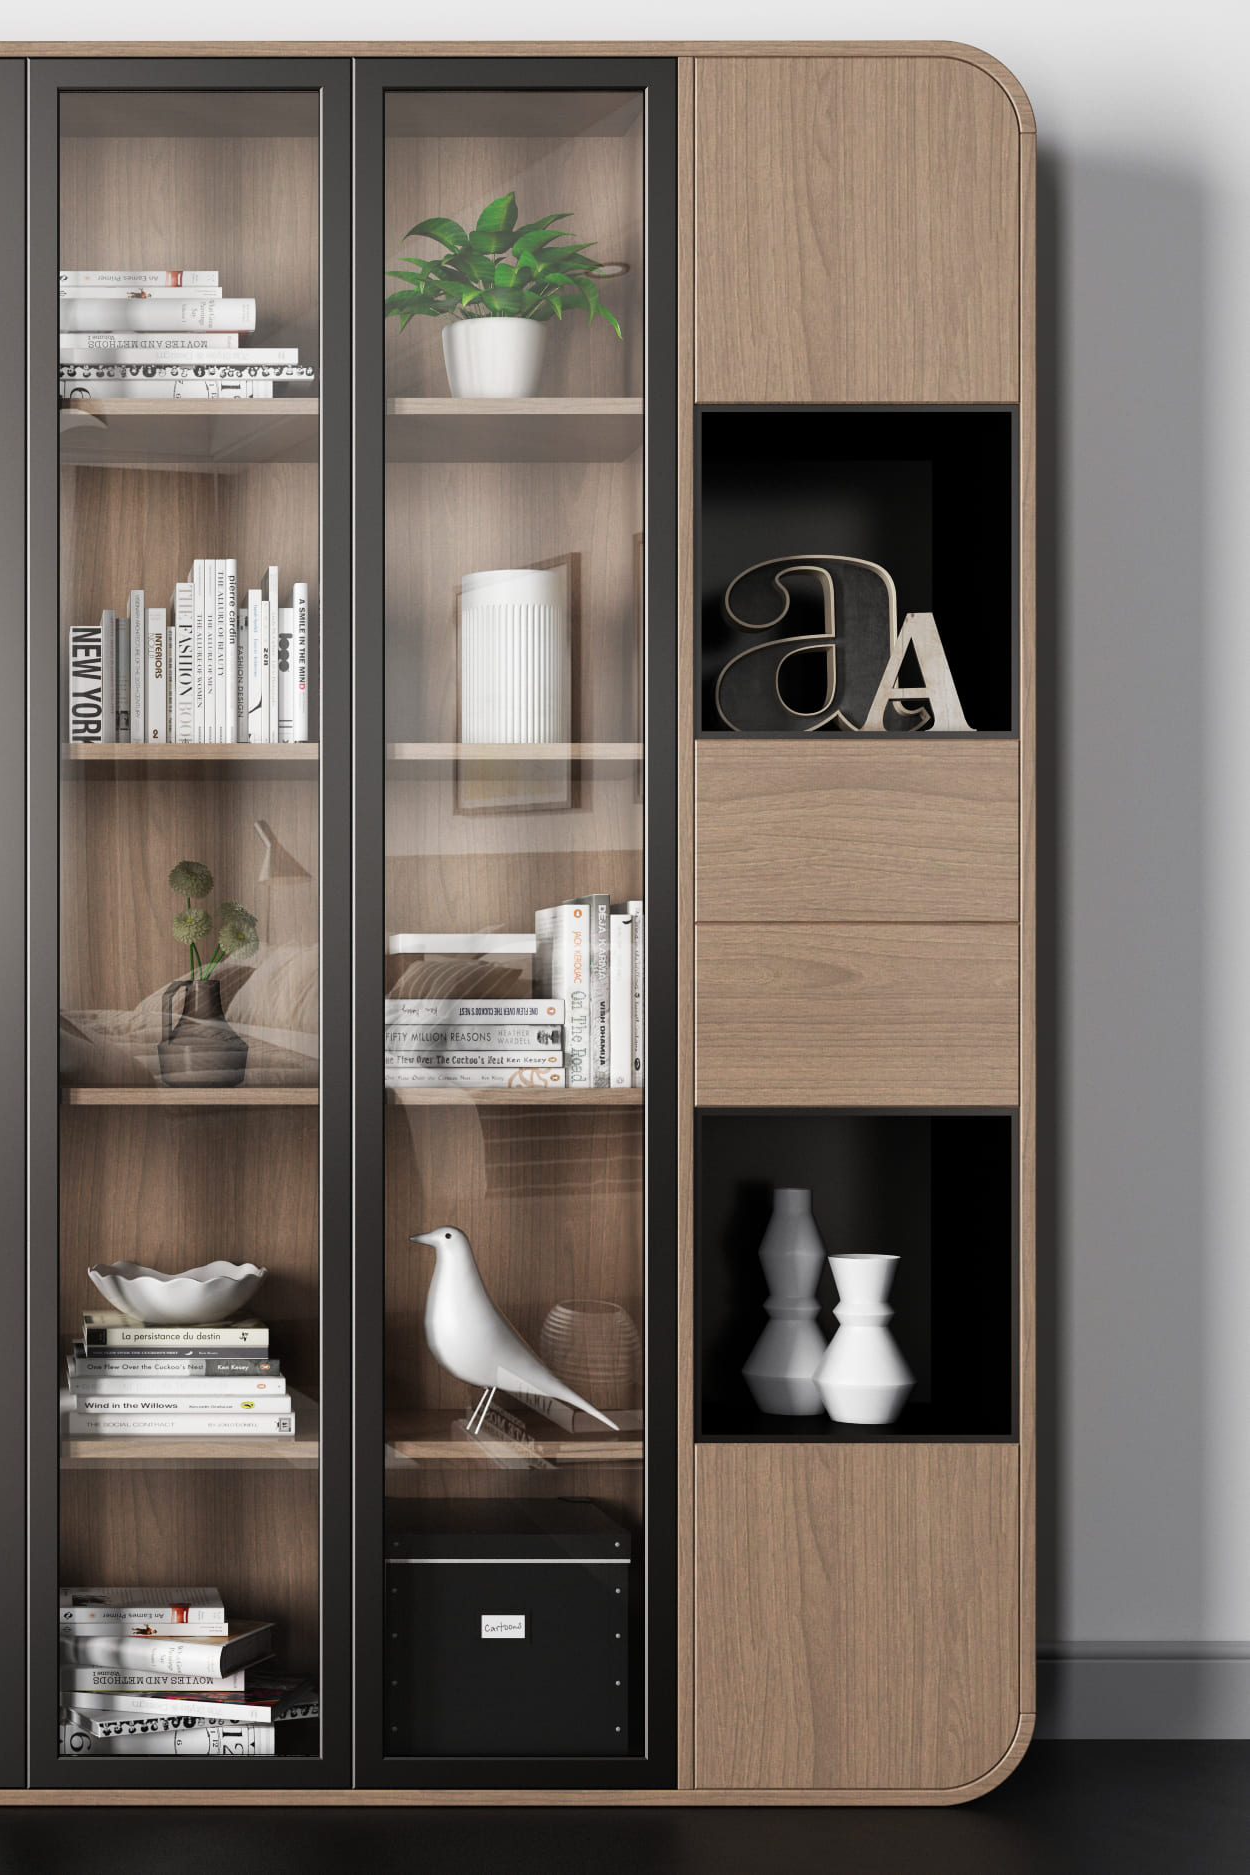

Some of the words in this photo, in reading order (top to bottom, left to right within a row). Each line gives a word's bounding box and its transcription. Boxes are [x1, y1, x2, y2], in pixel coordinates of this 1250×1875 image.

[88, 340, 138, 348] METHODS
[140, 340, 162, 348] AND
[166, 340, 208, 348] MOVIES
[228, 575, 237, 607] pierre
[178, 585, 192, 618] THE
[228, 610, 237, 644] cardin
[217, 627, 224, 640] OF
[299, 636, 305, 645] IN
[72, 628, 102, 680] NEW
[178, 624, 192, 696] FASHION
[197, 664, 202, 673] OF
[860, 612, 977, 731] A
[598, 904, 607, 934] DEJA
[598, 938, 607, 980] KARMA
[572, 950, 582, 984] KEROUAC
[570, 990, 587, 1009] On
[459, 1007, 470, 1016] NEST
[472, 1007, 493, 1016] CUCKOO'S
[494, 1007, 502, 1016] THE
[503, 1007, 515, 1016] OVER
[516, 1007, 528, 1016] FLEW
[528, 1007, 538, 1016] ONE
[570, 1015, 587, 1042] The
[385, 1033, 408, 1041] FIFTY
[411, 1033, 447, 1041] MILLION
[451, 1033, 491, 1041] REASONS
[570, 1047, 587, 1082] Road
[122, 1332, 131, 1340] La
[134, 1332, 180, 1341] persistance
[183, 1331, 195, 1340] du
[197, 1332, 221, 1340] destin
[484, 1621, 522, 1632] Cartoons
[92, 1676, 143, 1685] METHODS
[146, 1676, 168, 1685] AND
[171, 1676, 213, 1685] MOVIES
[70, 1731, 91, 1751] 6
